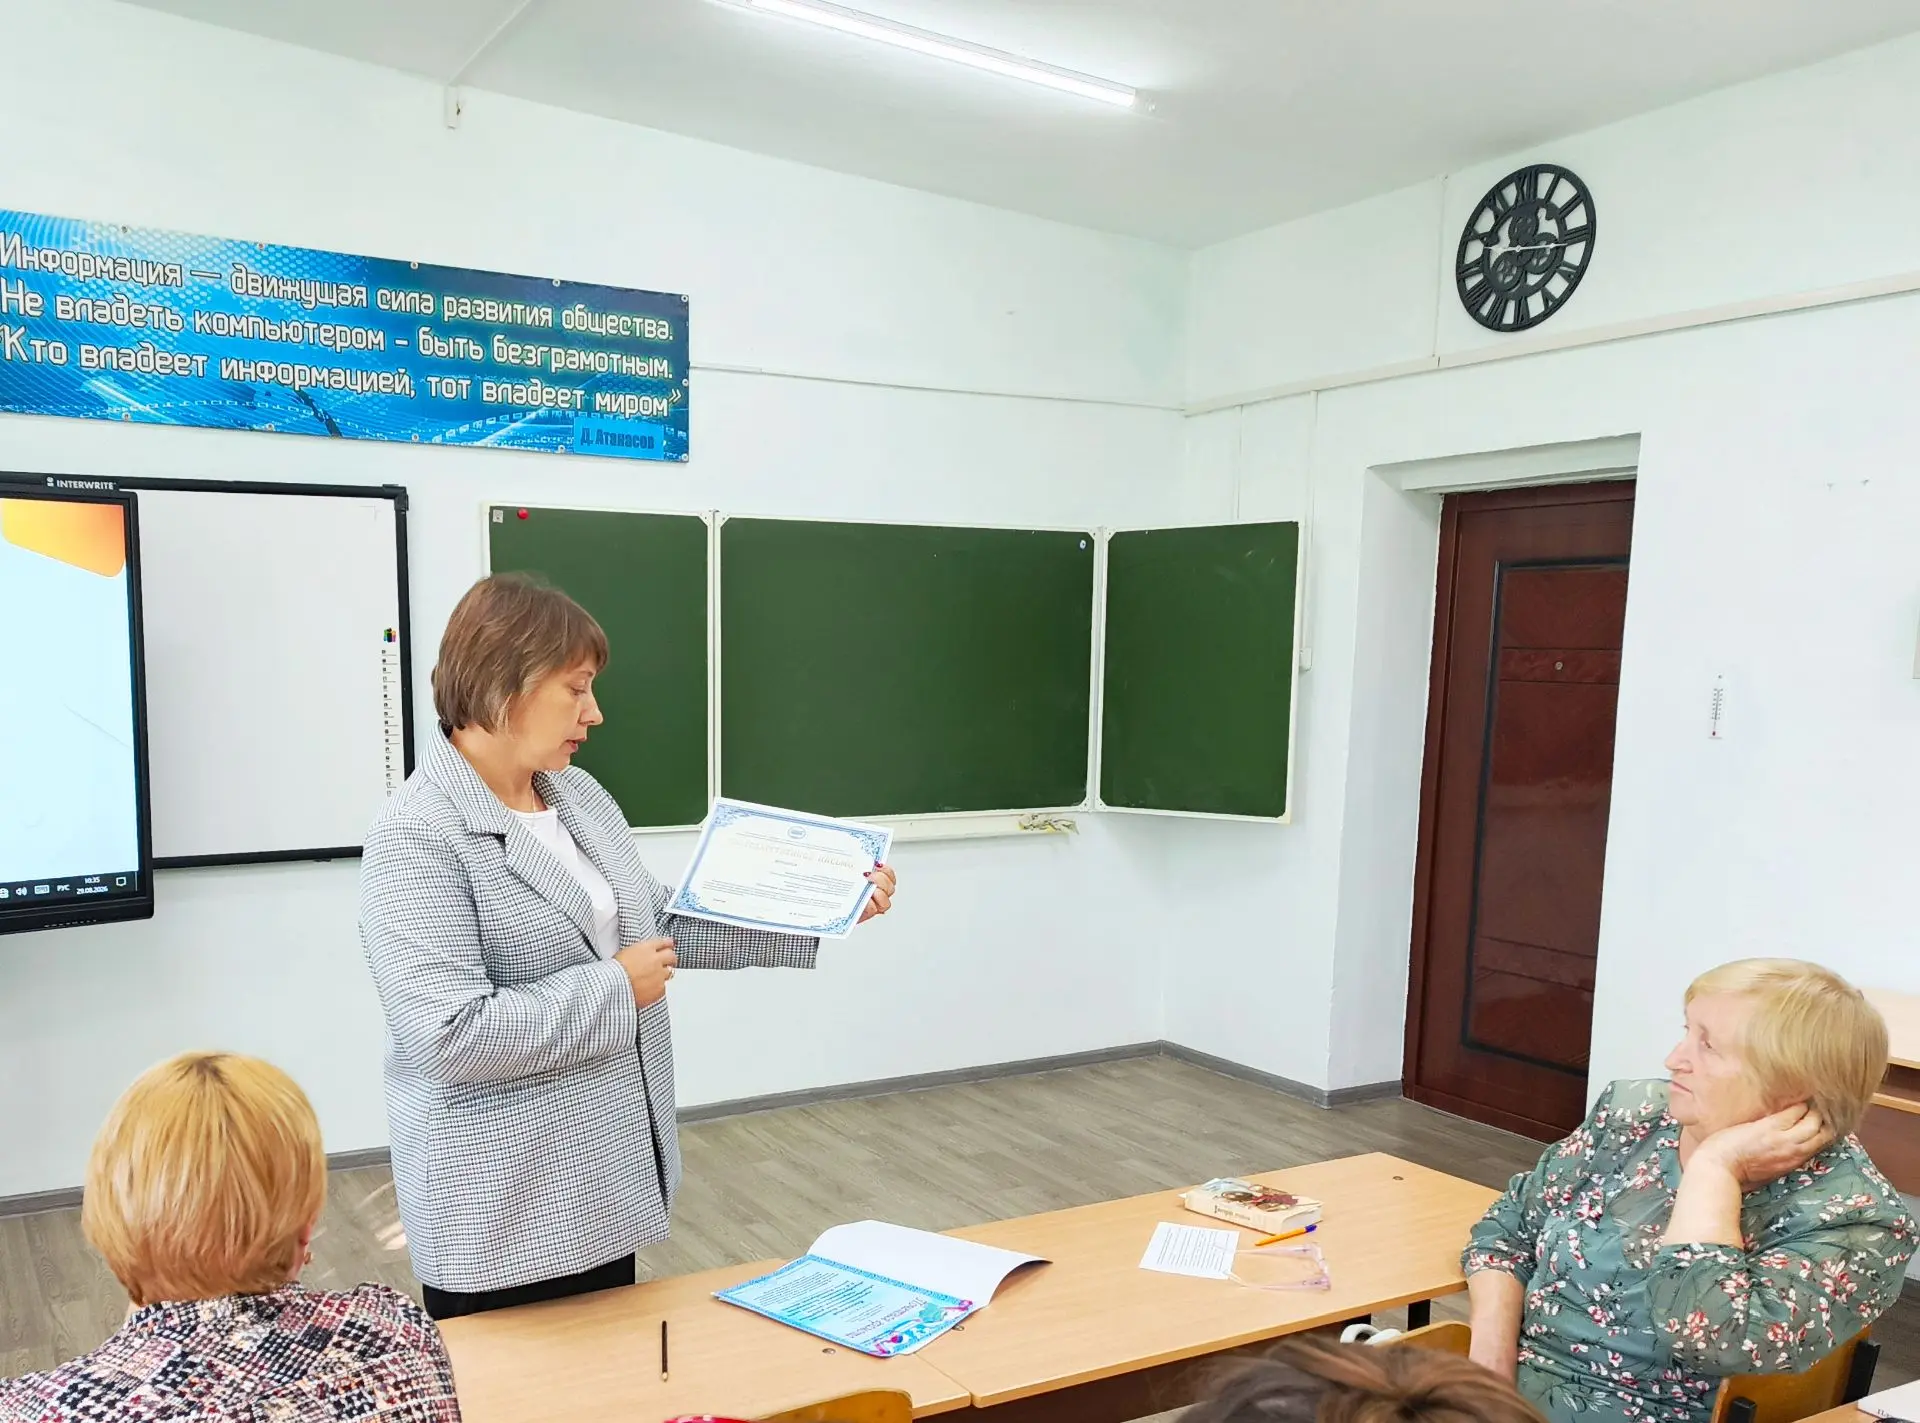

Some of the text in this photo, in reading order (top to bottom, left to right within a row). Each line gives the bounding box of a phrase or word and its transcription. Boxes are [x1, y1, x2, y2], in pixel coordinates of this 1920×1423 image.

[0, 231, 182, 287] Информация
[230, 263, 368, 310] движущая
[376, 287, 434, 315] сила
[442, 295, 553, 328] развития
[561, 304, 673, 341] общества.
[0, 277, 44, 317] Не
[55, 293, 184, 332] владеть
[194, 310, 385, 353] компьютером
[417, 326, 484, 362] быть
[492, 334, 673, 379] безграмотным.
[79, 341, 208, 378] владеет
[220, 358, 416, 399] информацией,
[427, 374, 472, 399] тот
[482, 378, 585, 410] владеет
[595, 388, 682, 418] миром»
[580, 427, 654, 449] Д. Атанасов
[56, 479, 114, 490] INTERWRITE
[57, 884, 70, 892] РУС
